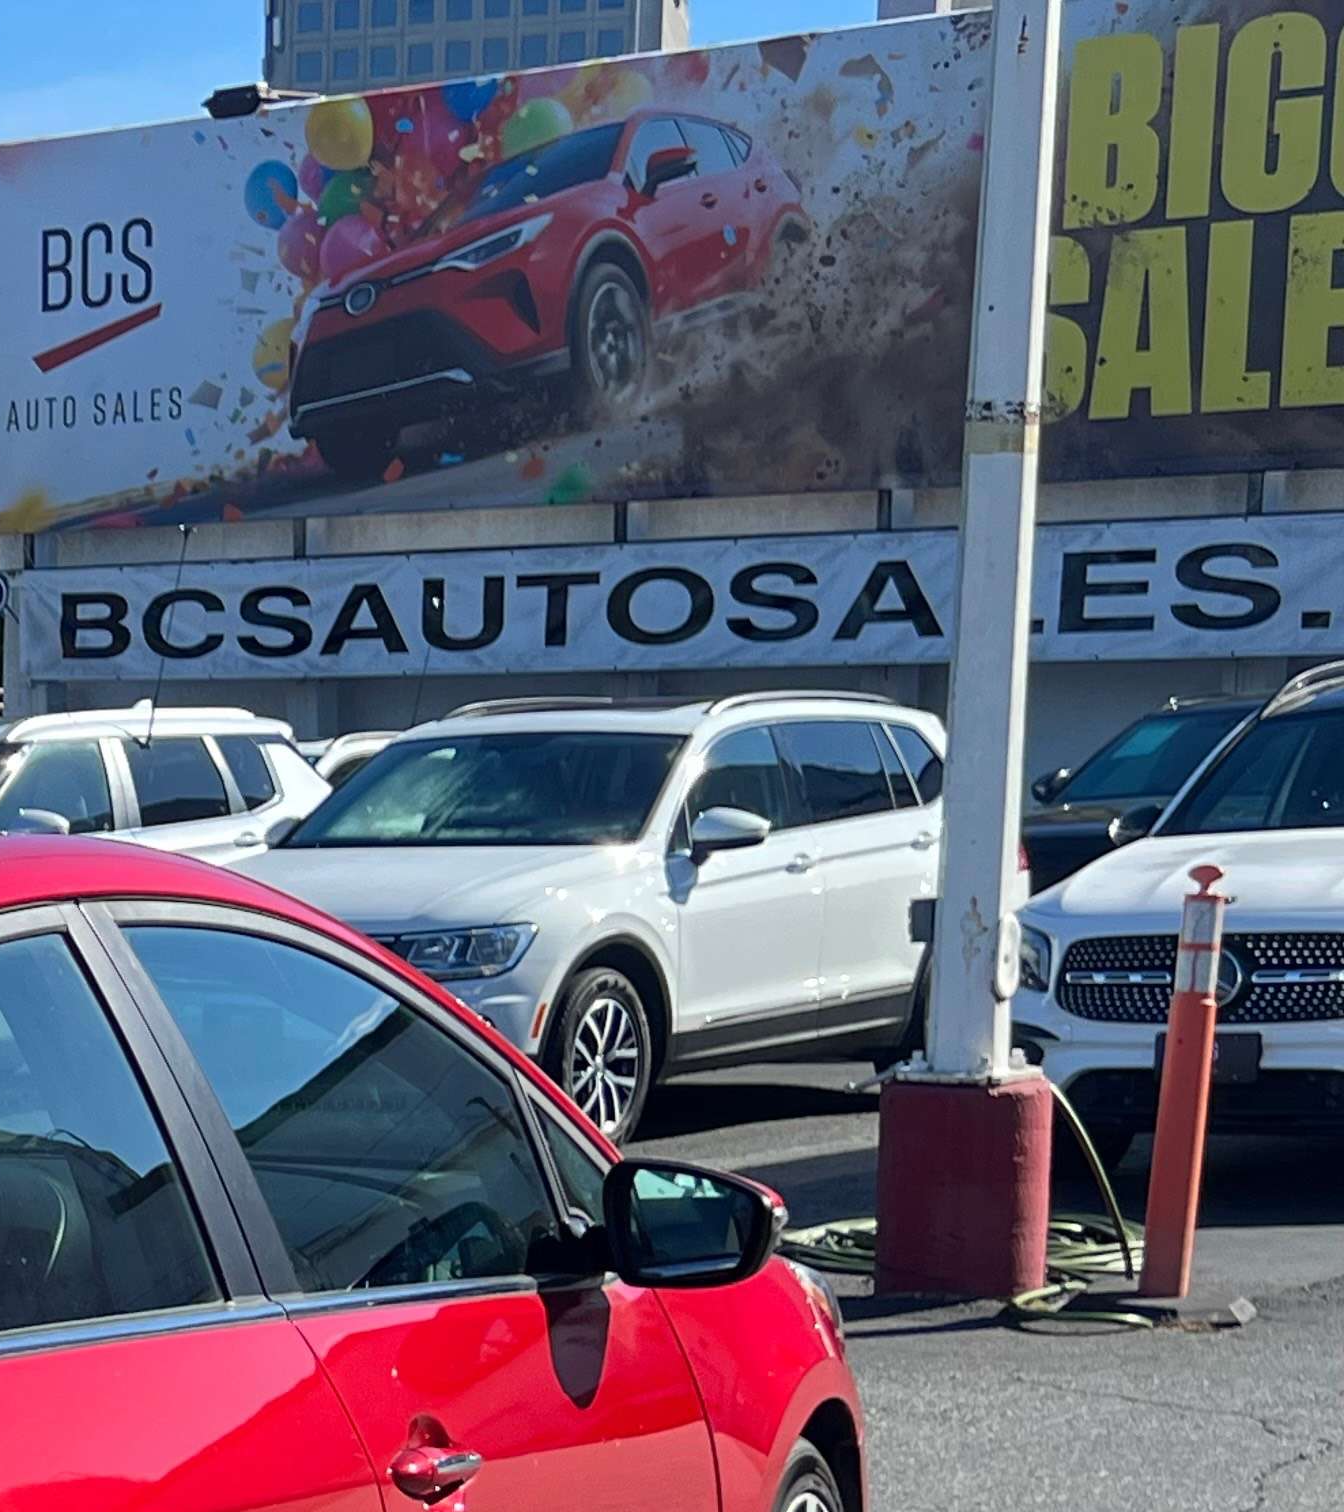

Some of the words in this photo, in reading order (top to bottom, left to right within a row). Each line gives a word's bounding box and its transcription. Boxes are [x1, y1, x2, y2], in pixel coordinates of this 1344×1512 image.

[1062, 11, 1344, 230] BIG
[41, 216, 156, 314] BCS
[6, 395, 78, 433] AUTO
[92, 386, 185, 427] SALES
[60, 542, 1331, 661] BCSAUTOSAES.
